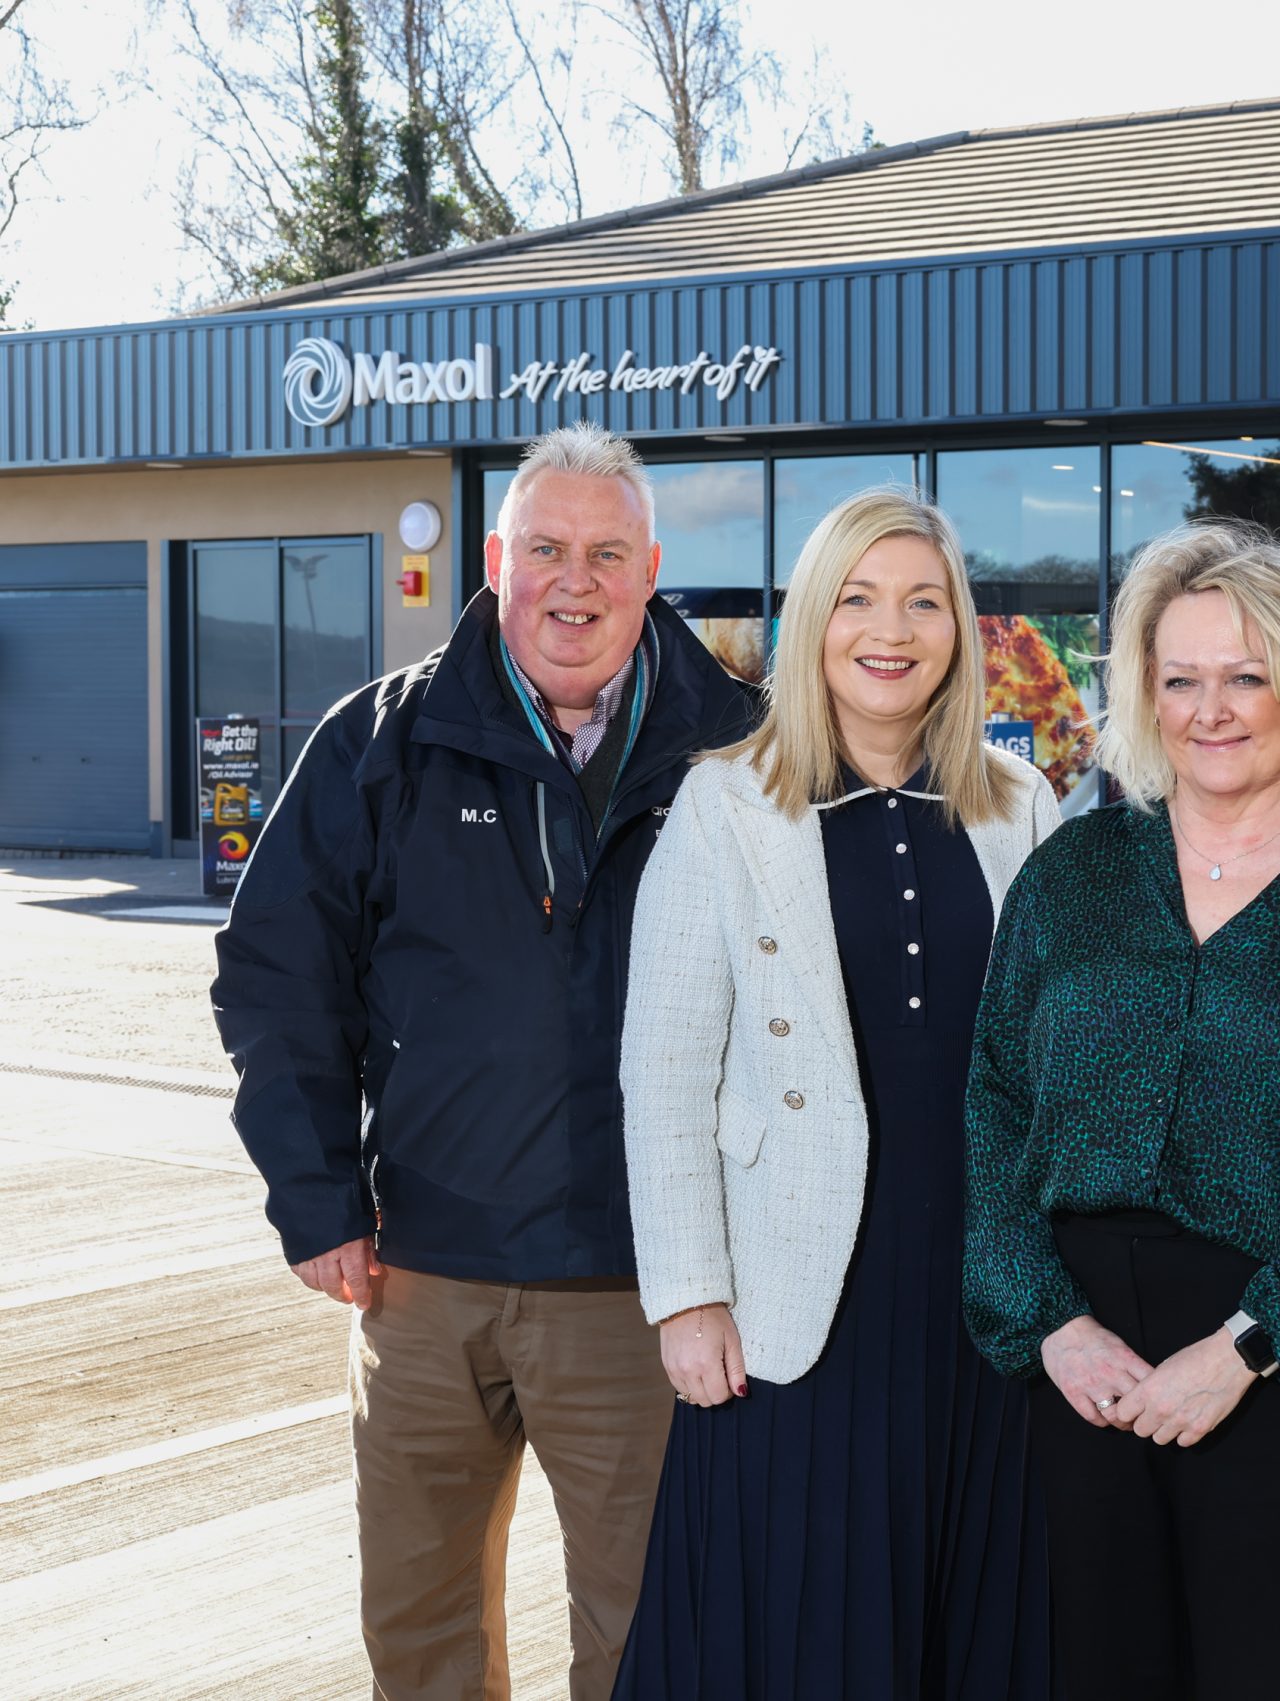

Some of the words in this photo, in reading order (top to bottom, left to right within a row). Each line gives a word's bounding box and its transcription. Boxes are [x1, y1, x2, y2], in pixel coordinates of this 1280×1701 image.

[353, 342, 493, 407] Maxol
[500, 361, 557, 403] At
[553, 352, 604, 401] the
[610, 350, 710, 395] heart
[703, 344, 750, 401] of
[744, 345, 780, 392] it
[222, 725, 240, 737] Get
[241, 724, 258, 737] the
[203, 736, 234, 756] Right
[235, 737, 256, 751] Oil!
[461, 808, 497, 823] M.C
[216, 861, 247, 872] Maxo
